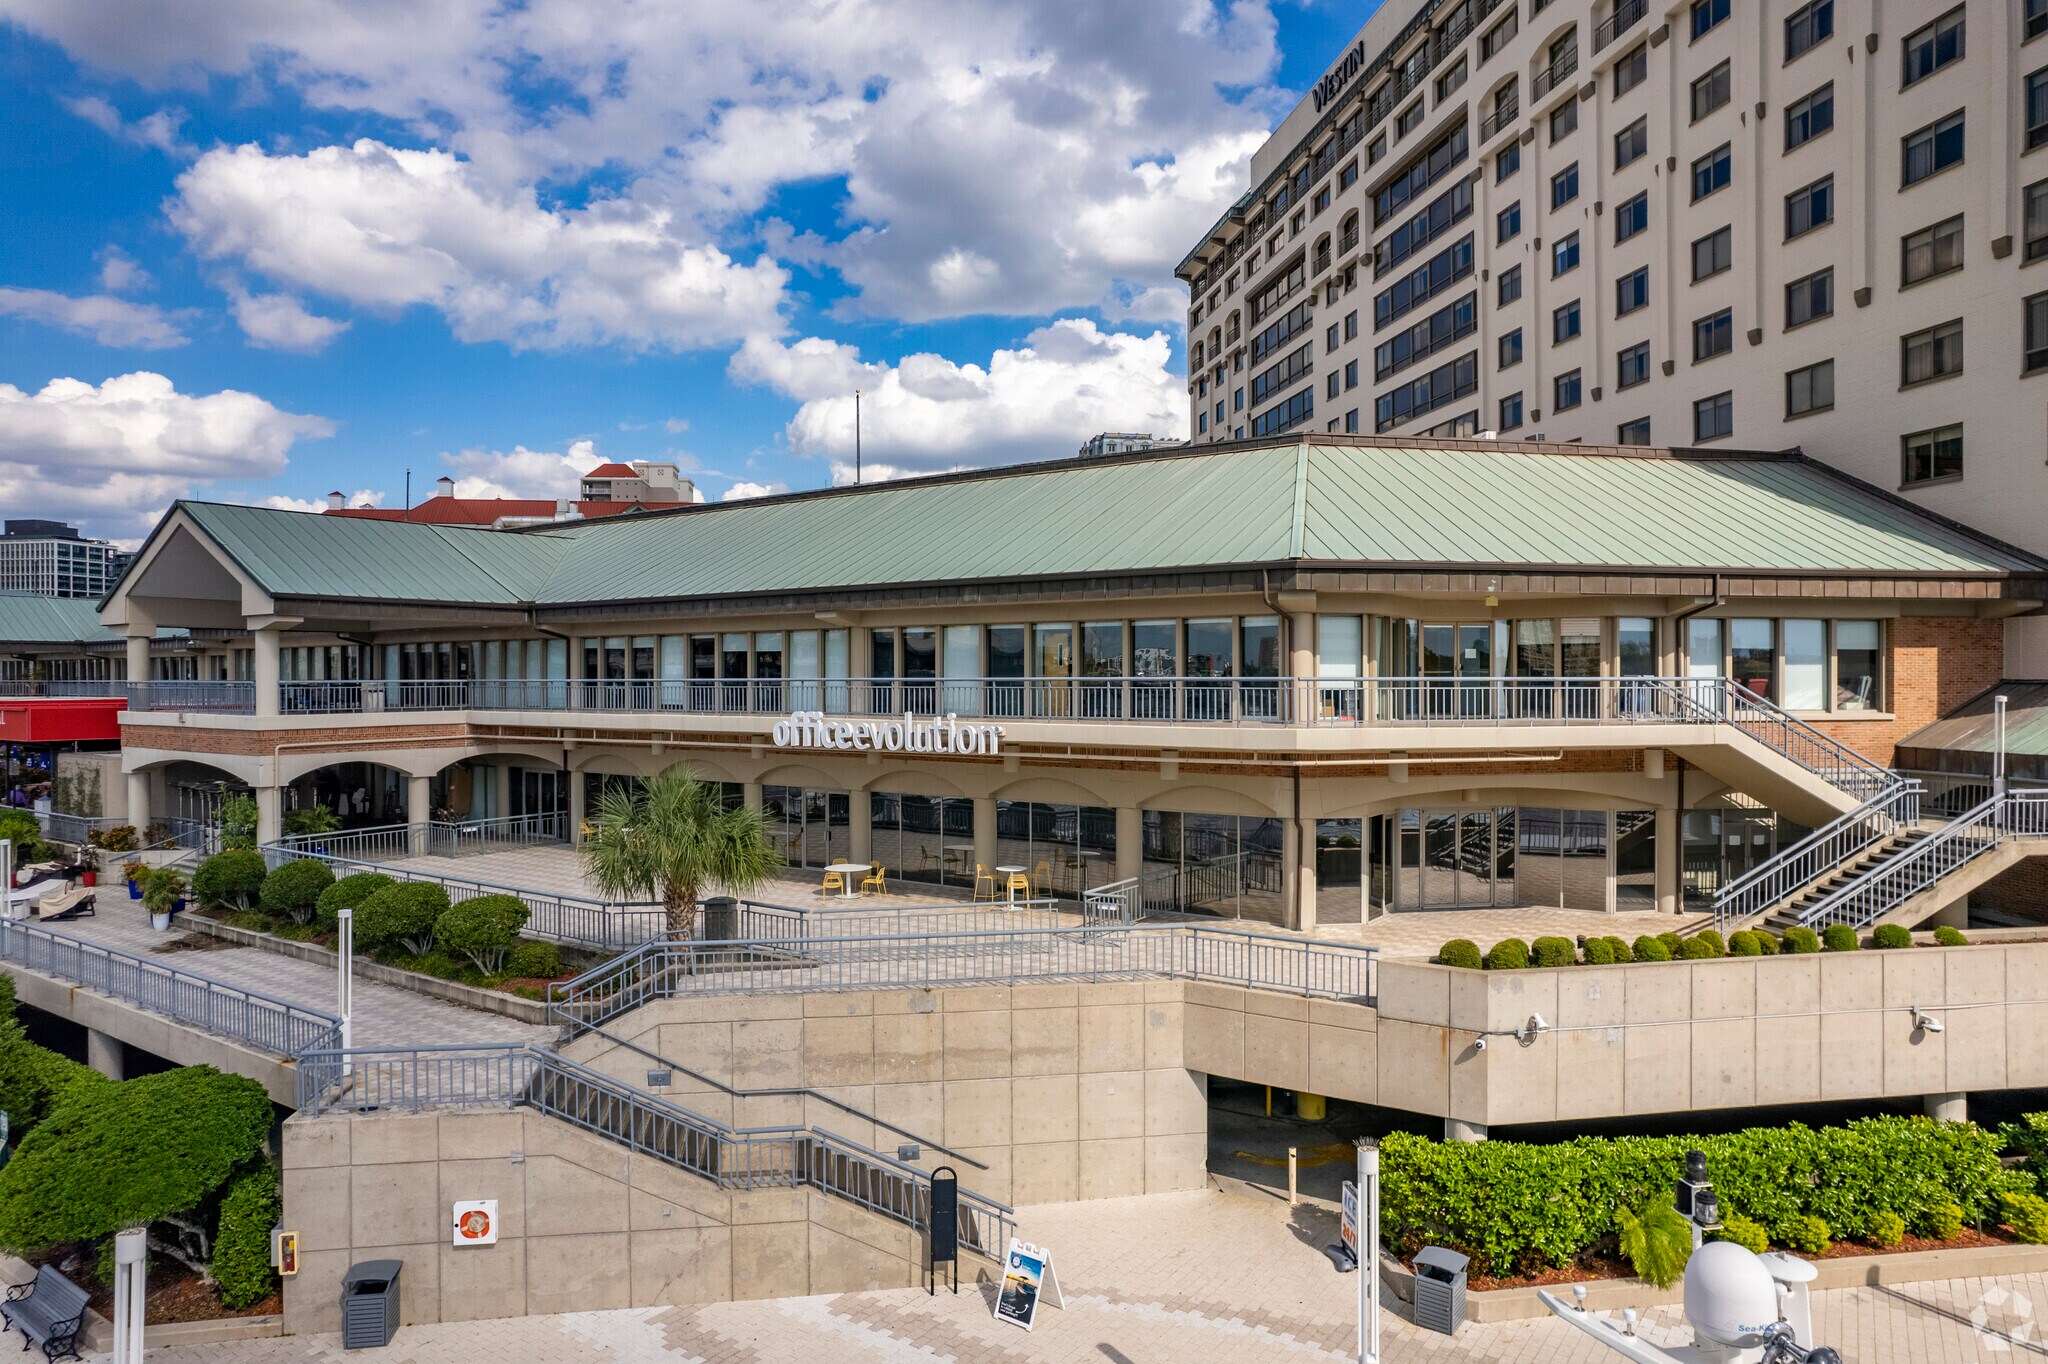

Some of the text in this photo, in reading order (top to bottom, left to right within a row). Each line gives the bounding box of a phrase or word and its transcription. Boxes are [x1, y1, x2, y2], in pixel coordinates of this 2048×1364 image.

[1312, 40, 1364, 113] WESTIN
[772, 710, 1000, 755] officeevolution
[1344, 1190, 1357, 1218] ICE
[1342, 1222, 1357, 1248] 24/7
[1738, 1324, 1767, 1333] Sea-K
